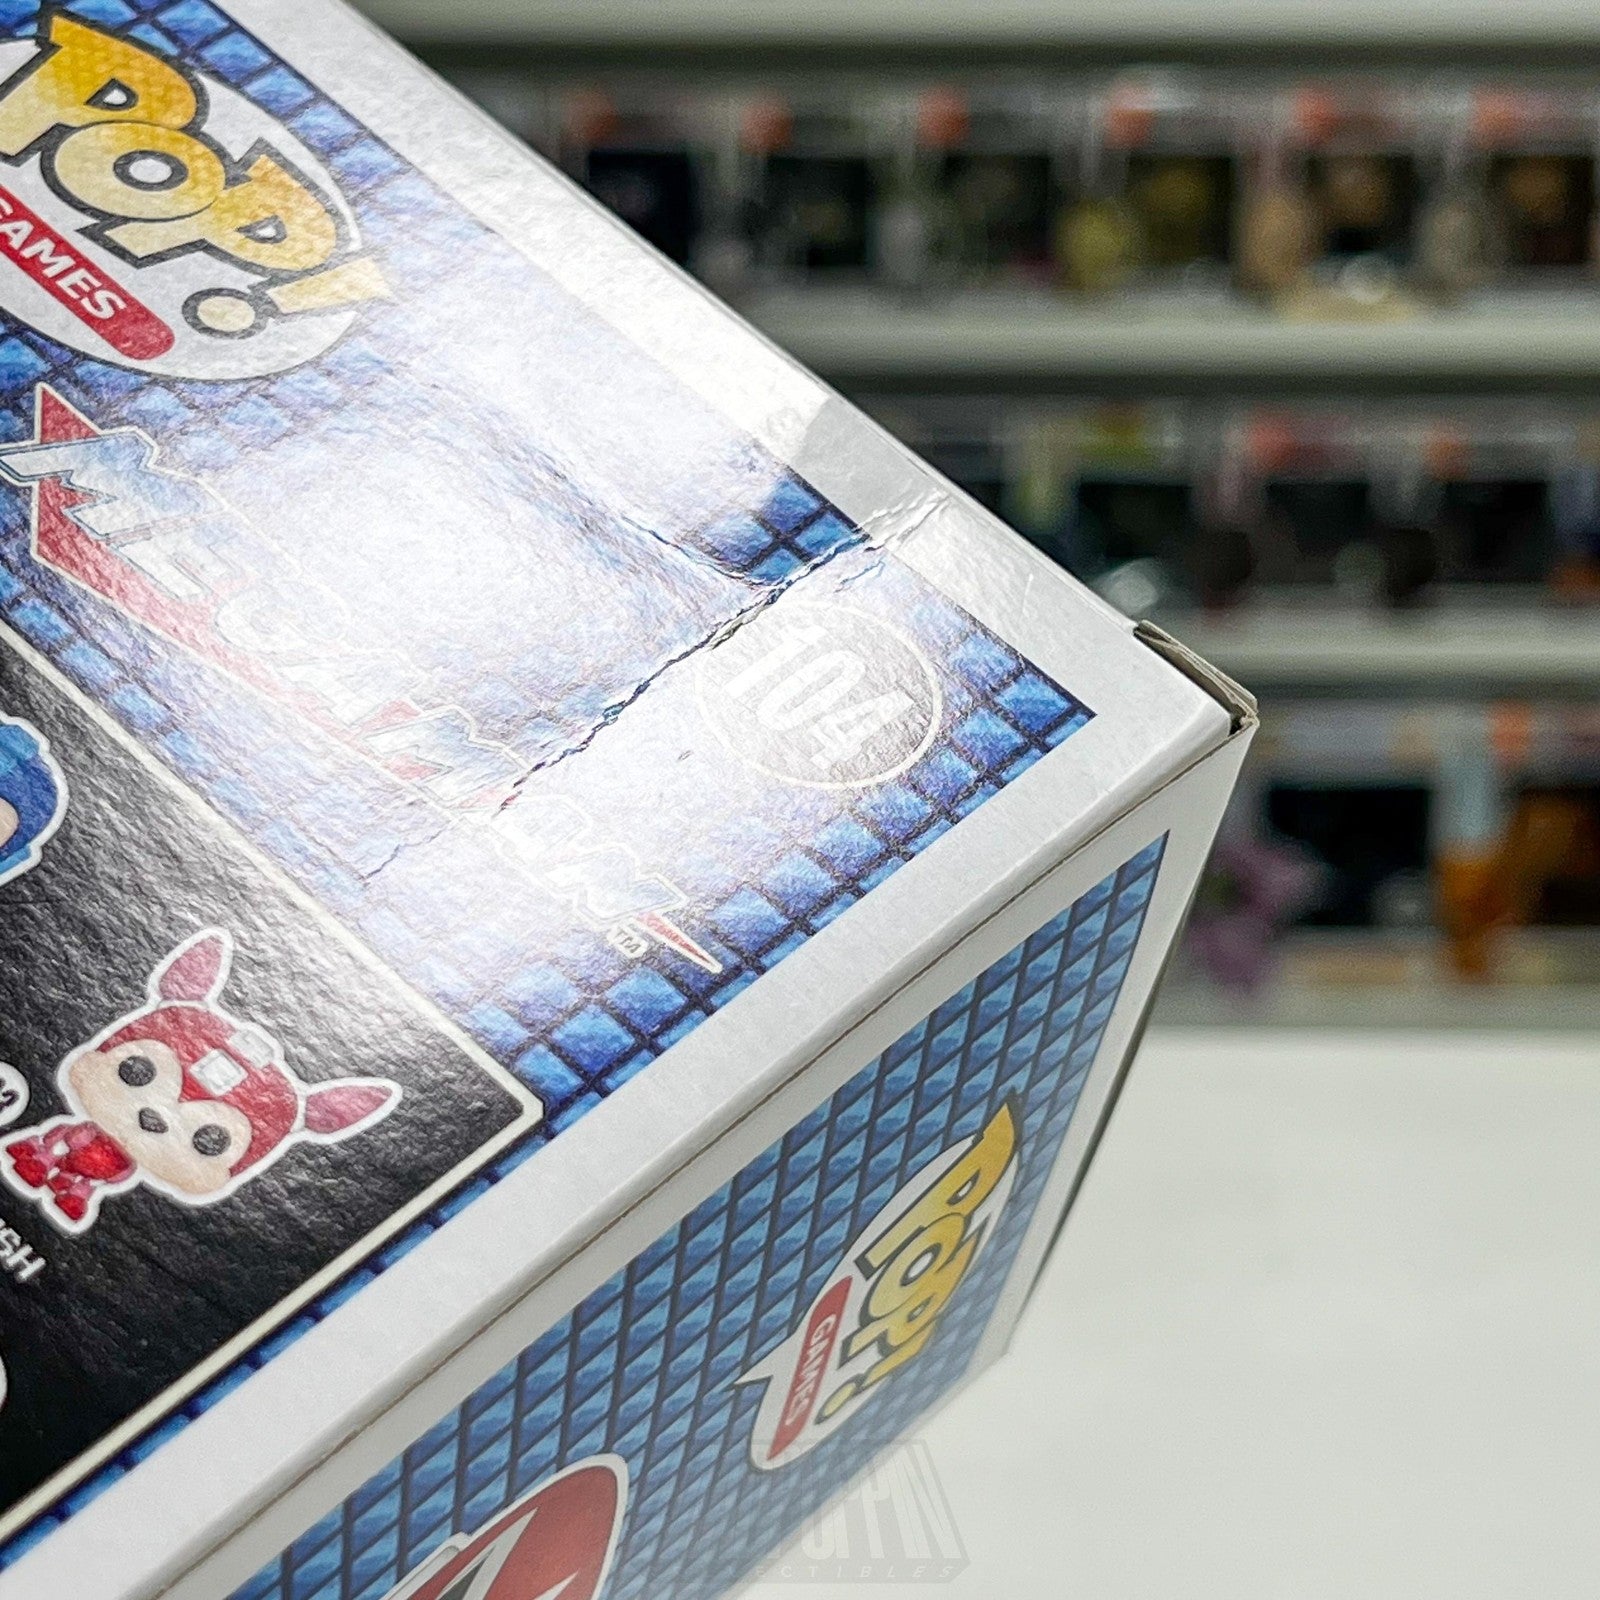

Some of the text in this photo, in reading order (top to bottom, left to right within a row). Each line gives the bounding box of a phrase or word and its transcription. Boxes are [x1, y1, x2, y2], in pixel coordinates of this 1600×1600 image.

[0, 8, 390, 340] POP!
[722, 625, 915, 770] 104
[0, 1219, 46, 1283] SH
[813, 1087, 1018, 1424] POP!
[784, 1313, 837, 1426] GAMES
